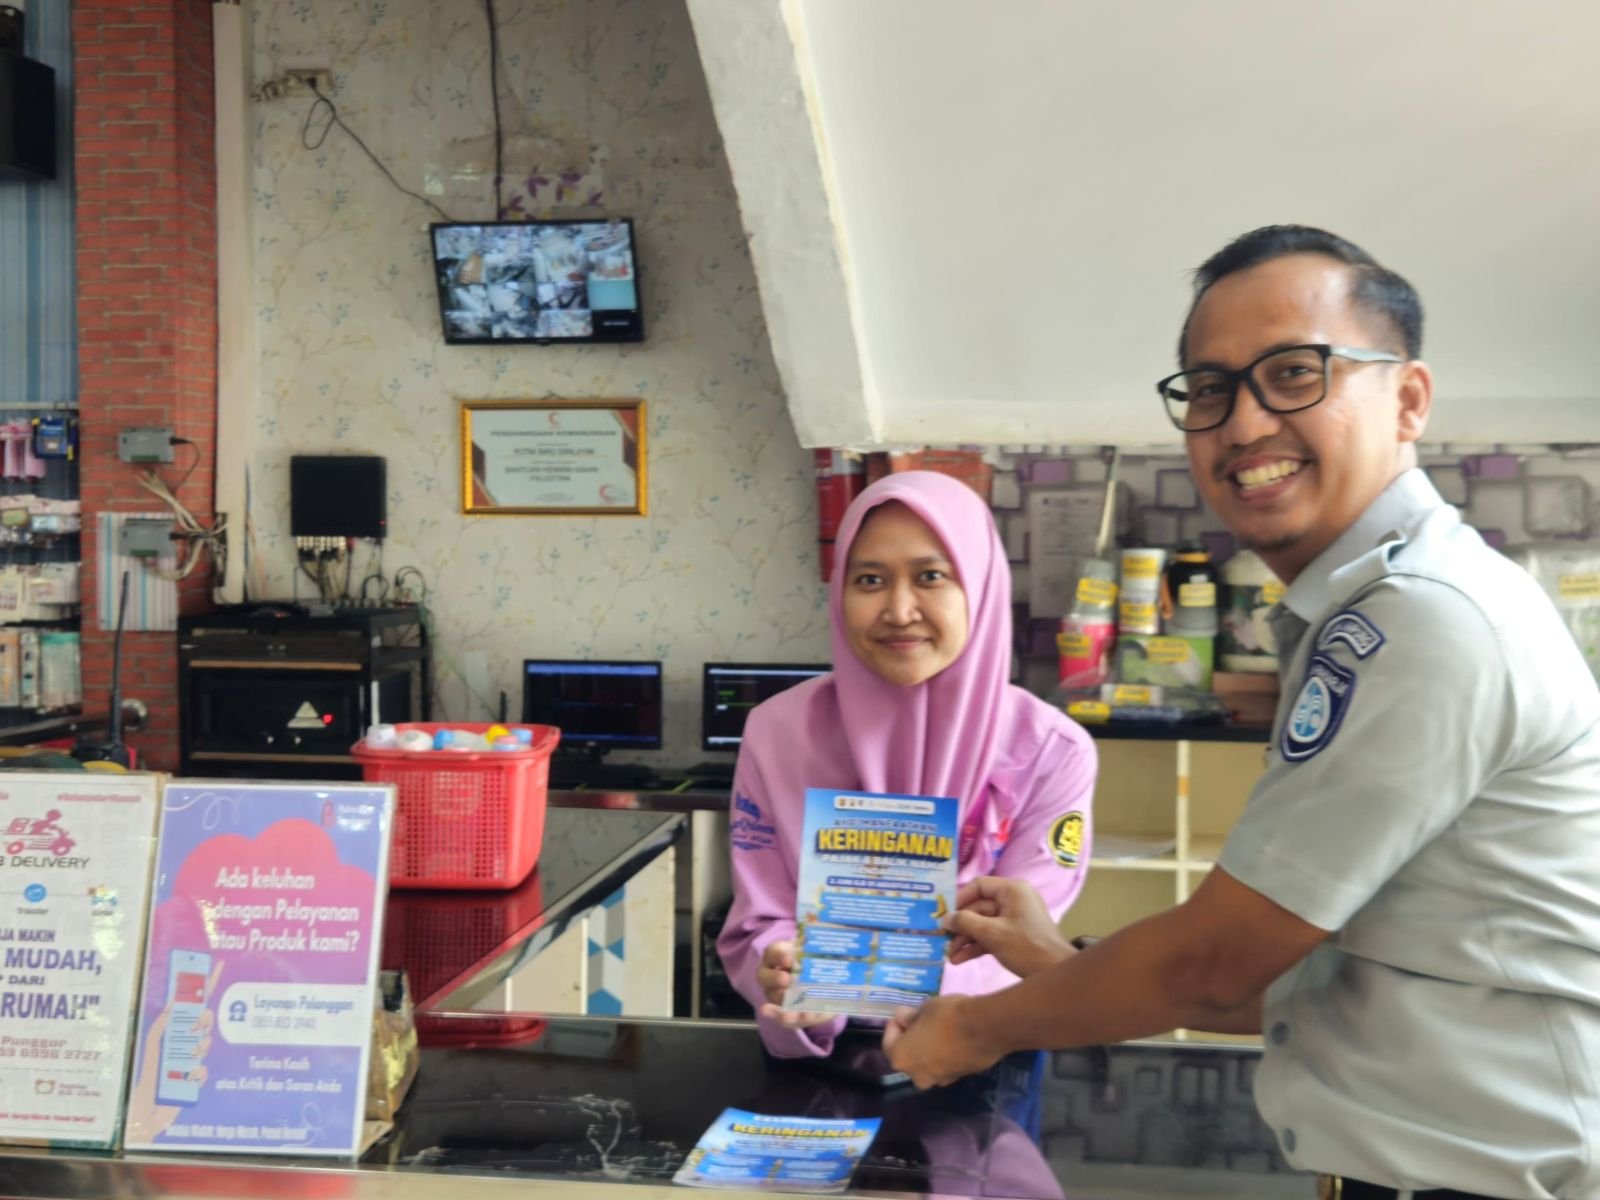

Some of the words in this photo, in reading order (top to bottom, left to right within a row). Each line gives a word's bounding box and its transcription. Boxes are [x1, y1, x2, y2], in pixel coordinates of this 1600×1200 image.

[818, 828, 954, 860] KERINGANAN
[11, 856, 90, 869] DELIVERY
[214, 865, 248, 888] Ada
[251, 866, 315, 889] keluhan
[212, 897, 272, 926] dengan
[275, 898, 359, 927] Pelayanan
[210, 931, 246, 950] atau
[250, 929, 306, 951] Produk
[310, 929, 360, 953] kami?
[4, 947, 102, 975] MUDAH,
[8, 975, 45, 985] DARI
